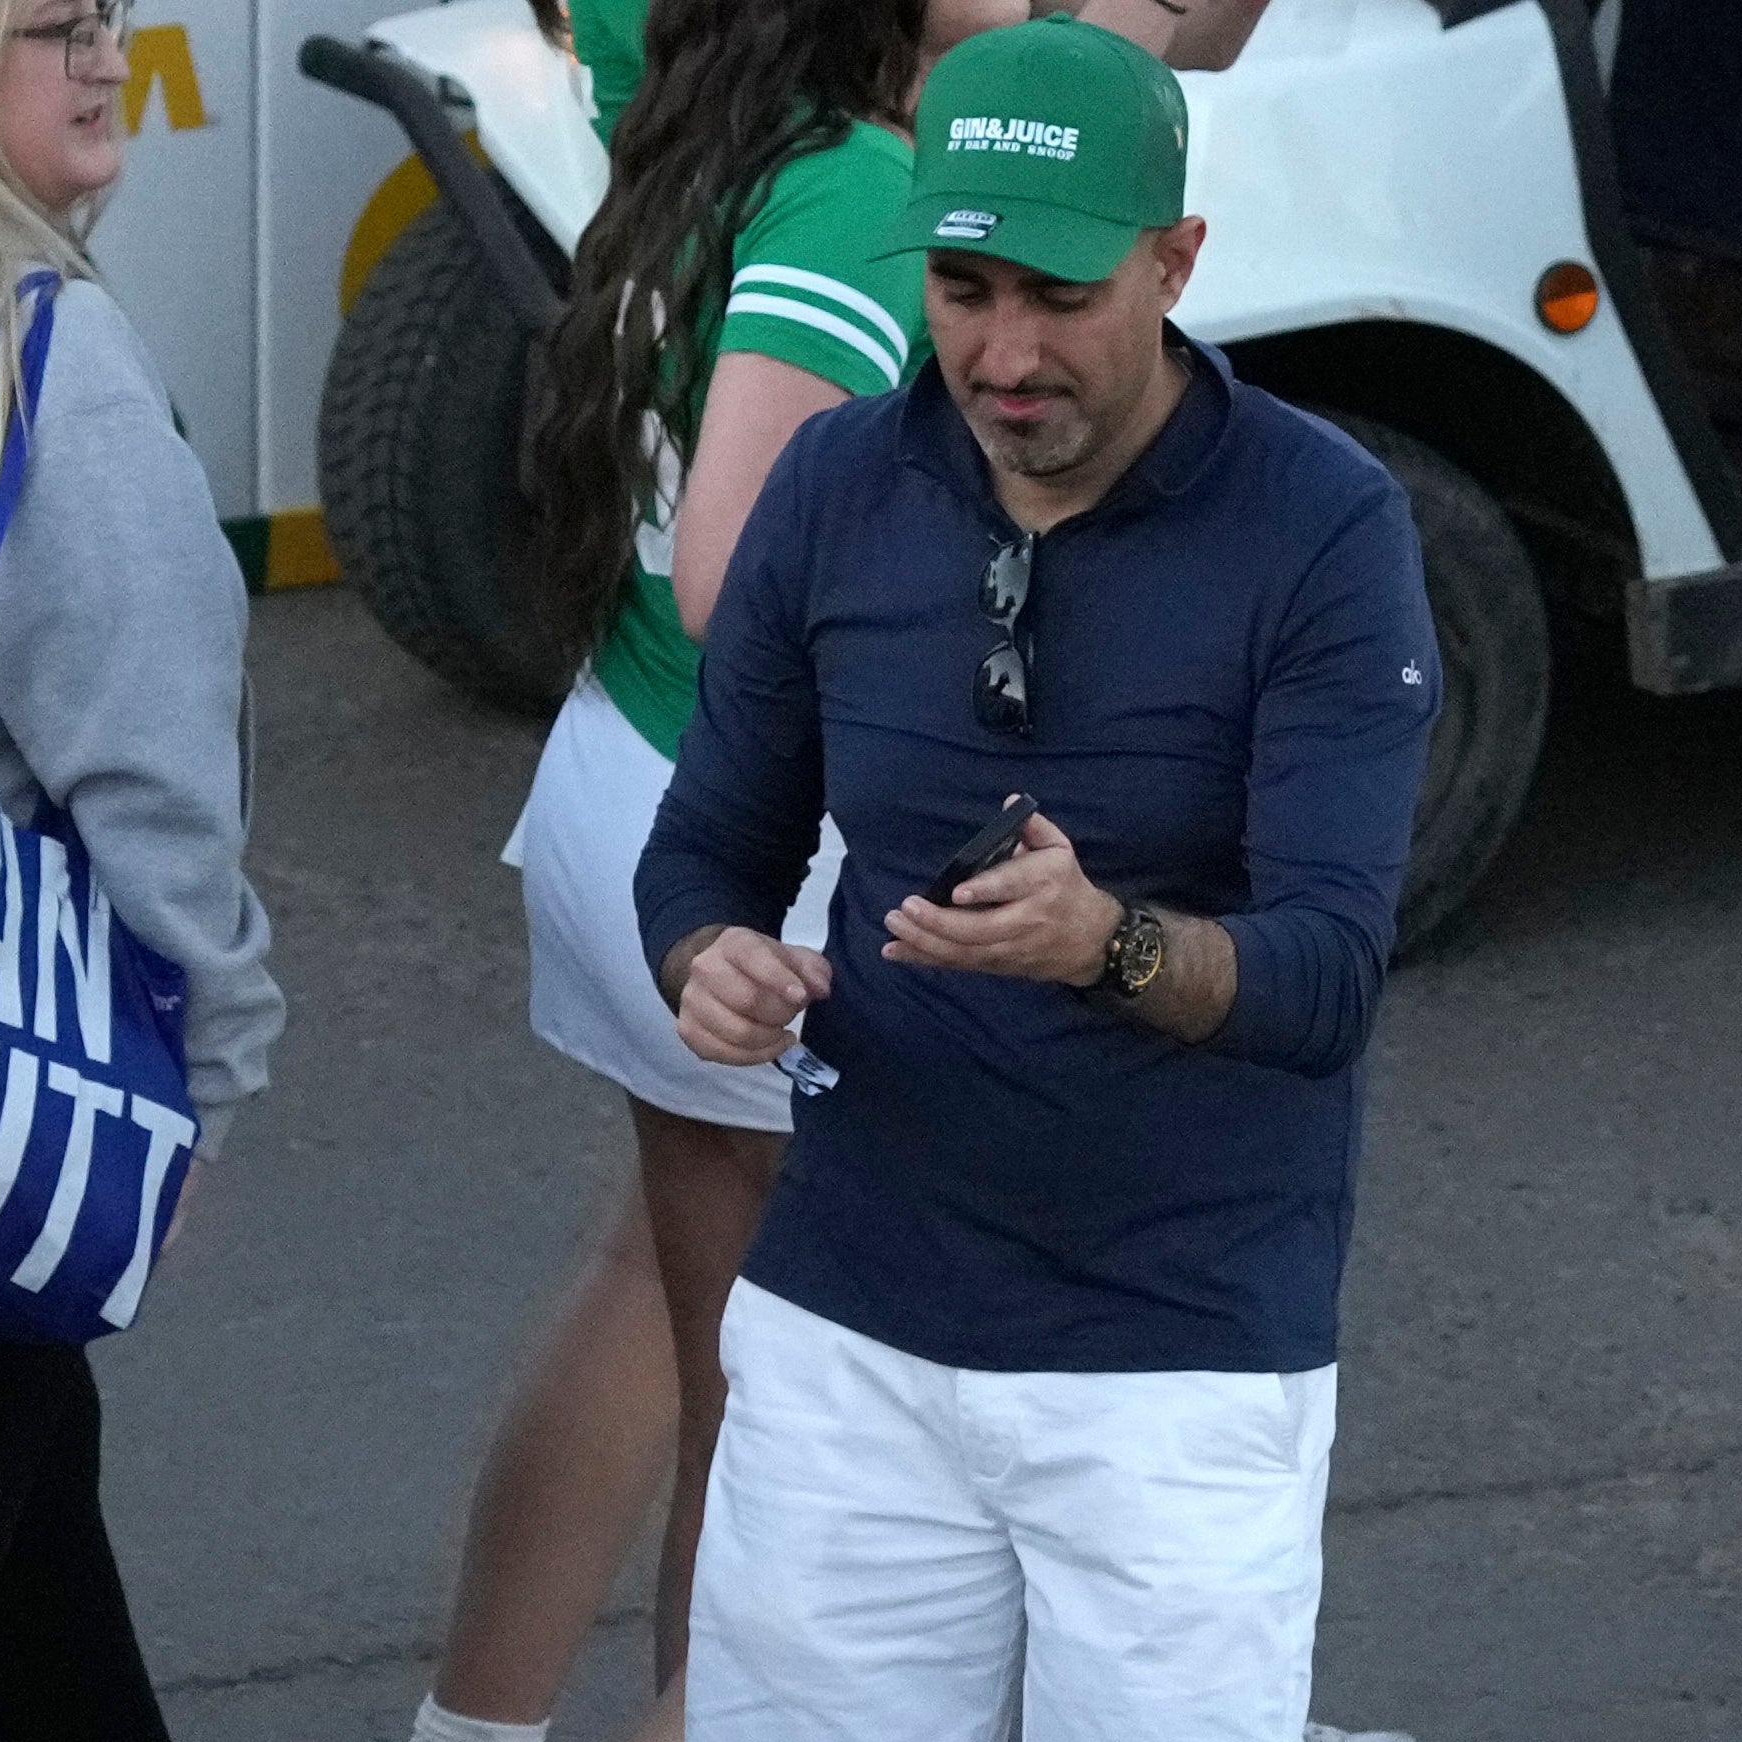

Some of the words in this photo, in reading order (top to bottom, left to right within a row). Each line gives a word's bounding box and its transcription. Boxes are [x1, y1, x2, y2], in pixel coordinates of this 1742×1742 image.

[949, 117, 1079, 151] GIN&JUICE
[993, 140, 1021, 152] AND
[1402, 659, 1422, 685] alo
